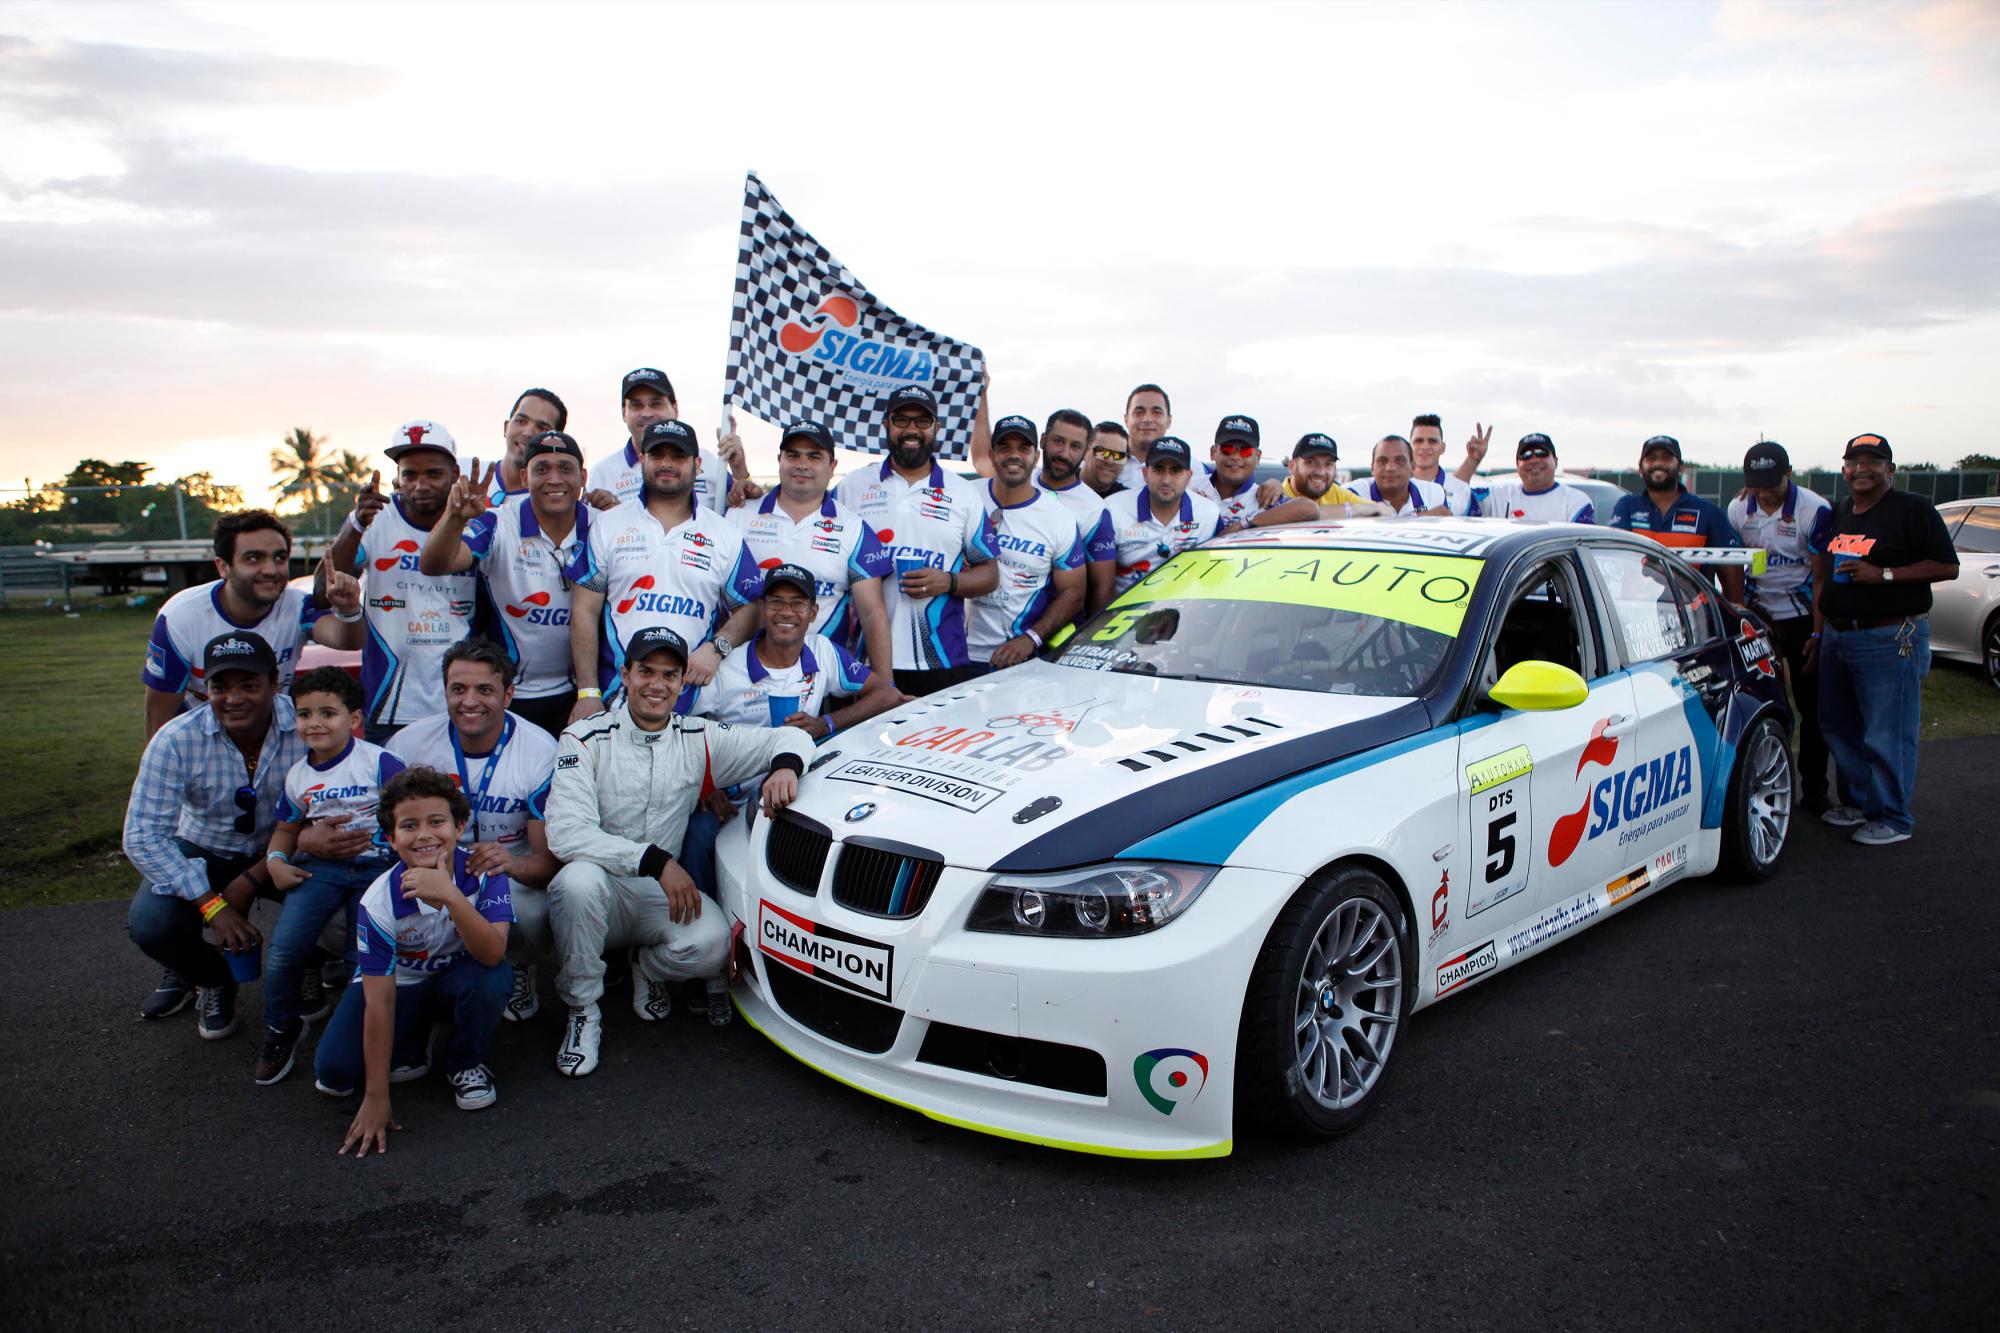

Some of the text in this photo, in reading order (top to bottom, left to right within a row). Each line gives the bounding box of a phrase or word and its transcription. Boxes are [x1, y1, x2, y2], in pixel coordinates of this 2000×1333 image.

[814, 329, 933, 382] SIGMA
[813, 540, 840, 550] CHAMPION
[881, 545, 945, 570] IGMA
[997, 534, 1046, 557] GMA
[683, 555, 711, 567] CHAMPION
[998, 559, 1026, 570] UTO
[1142, 557, 1470, 604] CITY AUTO
[528, 608, 571, 626] SIG
[636, 592, 706, 620] SIGMA
[408, 622, 450, 633] CARLAB
[1091, 609, 1150, 641] 5
[743, 688, 769, 699] CARLA
[644, 734, 662, 743] OMP
[896, 725, 1075, 772] CARLAB
[558, 756, 579, 768] OMP
[312, 785, 368, 804] SIGMA
[845, 764, 988, 803] LEATHER DIVISION
[1587, 744, 1692, 841] SIGMA
[1489, 789, 1513, 813] DTS
[1646, 816, 1664, 837] para
[1485, 811, 1517, 884] 5
[1655, 844, 1688, 873] CARLAB
[1507, 892, 1600, 957] www.unicaribe.edu.do
[764, 919, 885, 983] CHAMPION
[1439, 951, 1495, 986] CHAMPION
